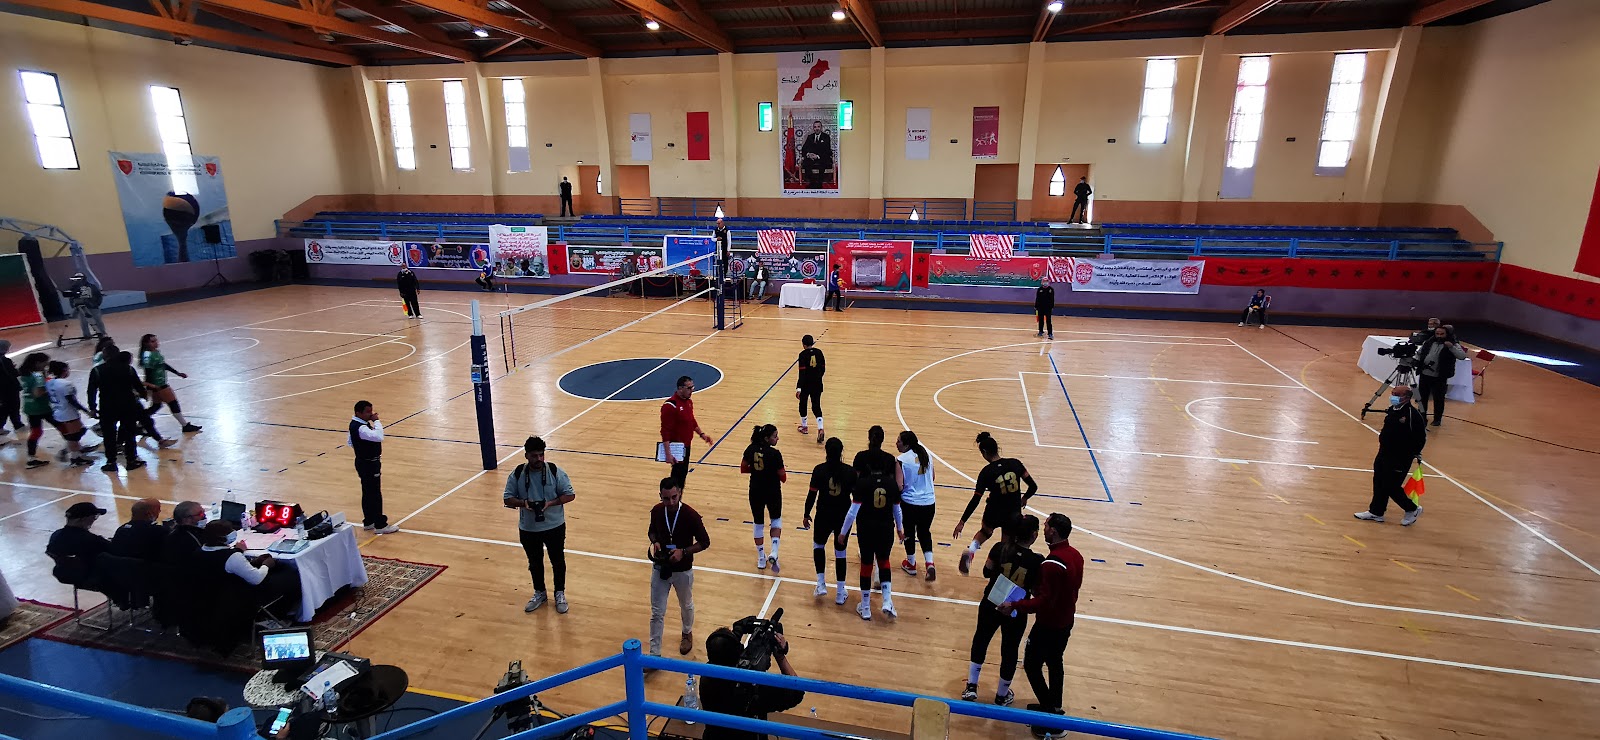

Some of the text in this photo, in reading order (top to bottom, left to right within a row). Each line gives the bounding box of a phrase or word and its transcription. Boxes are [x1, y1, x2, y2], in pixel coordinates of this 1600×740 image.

[801, 51, 814, 65] الله
[781, 75, 800, 84] الملك
[816, 80, 838, 91] الوطن
[809, 355, 817, 368] 4
[753, 451, 765, 471] 5
[828, 476, 842, 496] 9
[994, 471, 1019, 495] 13
[873, 487, 887, 509] 6
[266, 505, 290, 518] 6 8
